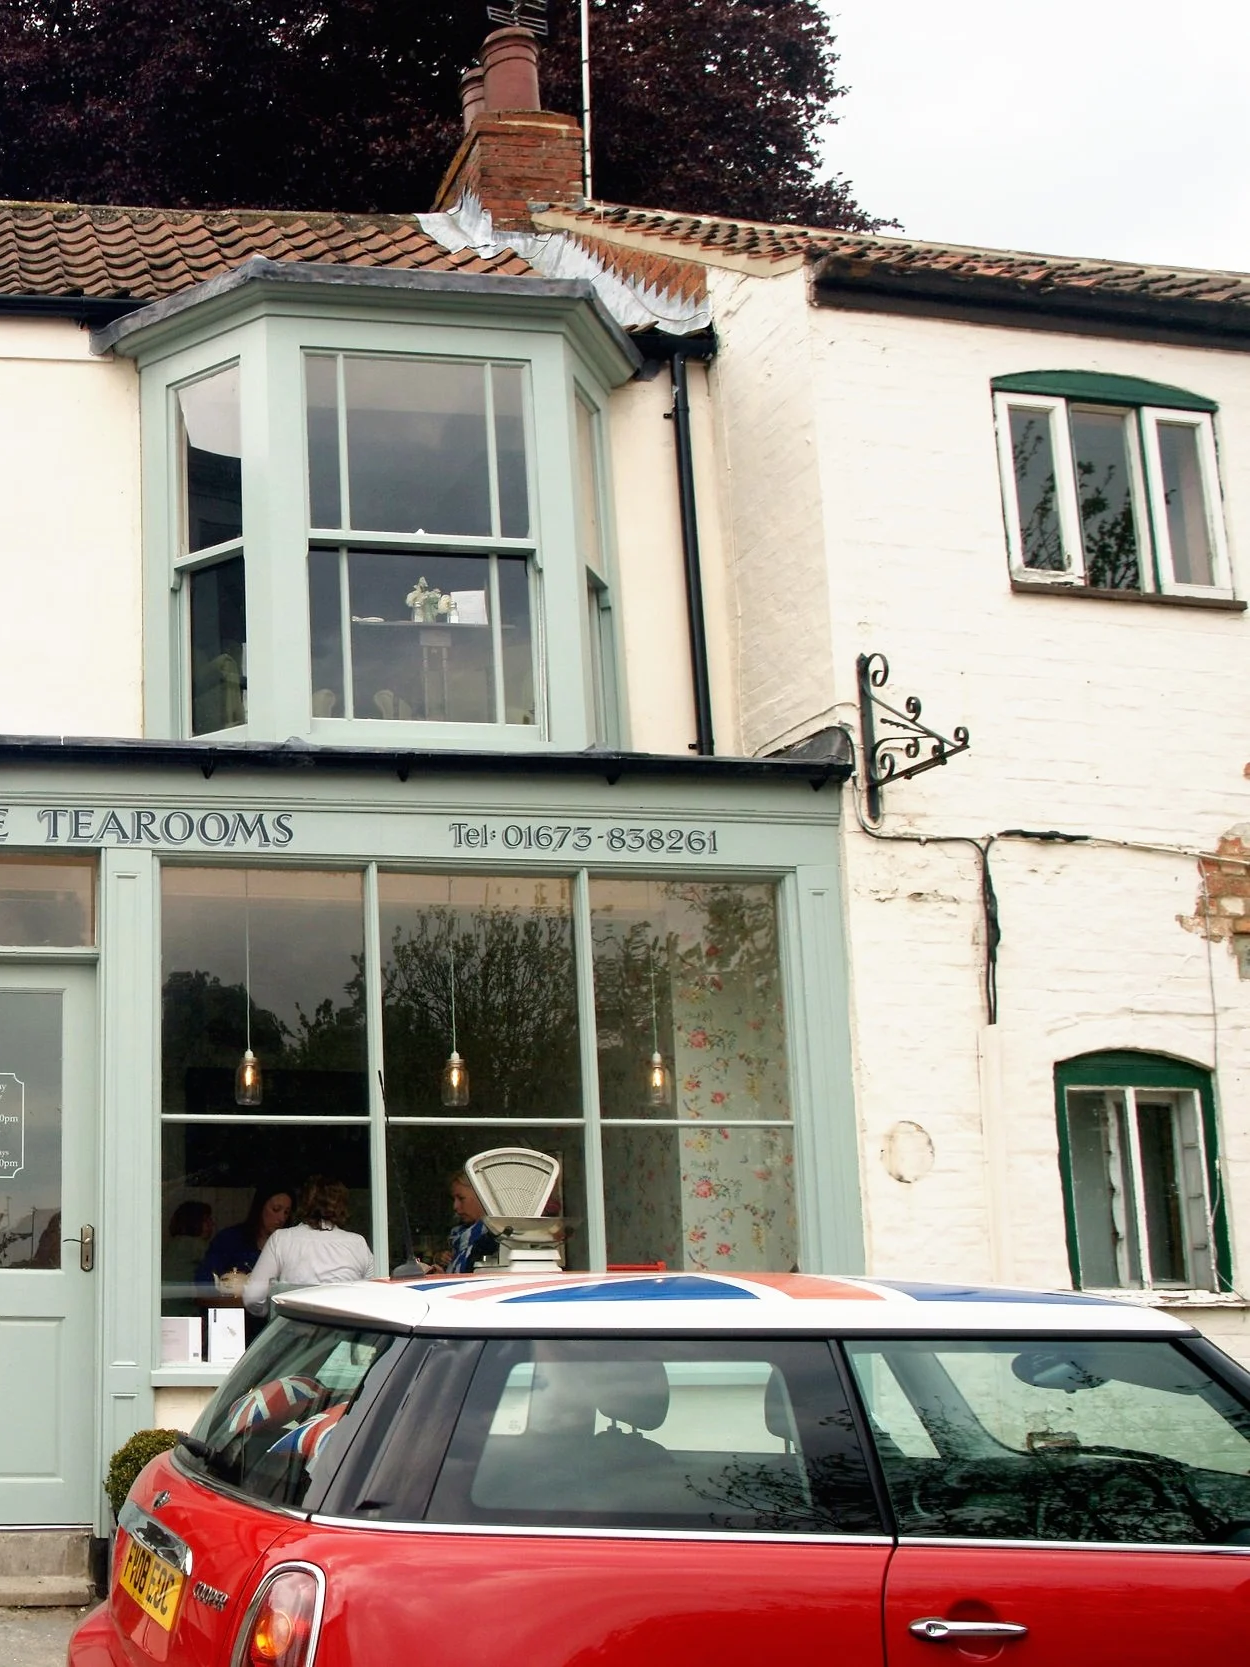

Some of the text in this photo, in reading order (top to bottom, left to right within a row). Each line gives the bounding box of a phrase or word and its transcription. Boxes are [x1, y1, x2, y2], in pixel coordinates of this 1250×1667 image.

[37, 809, 294, 848] TEAROOMS
[450, 823, 496, 848] Tel:
[193, 1581, 229, 1612] COOPER
